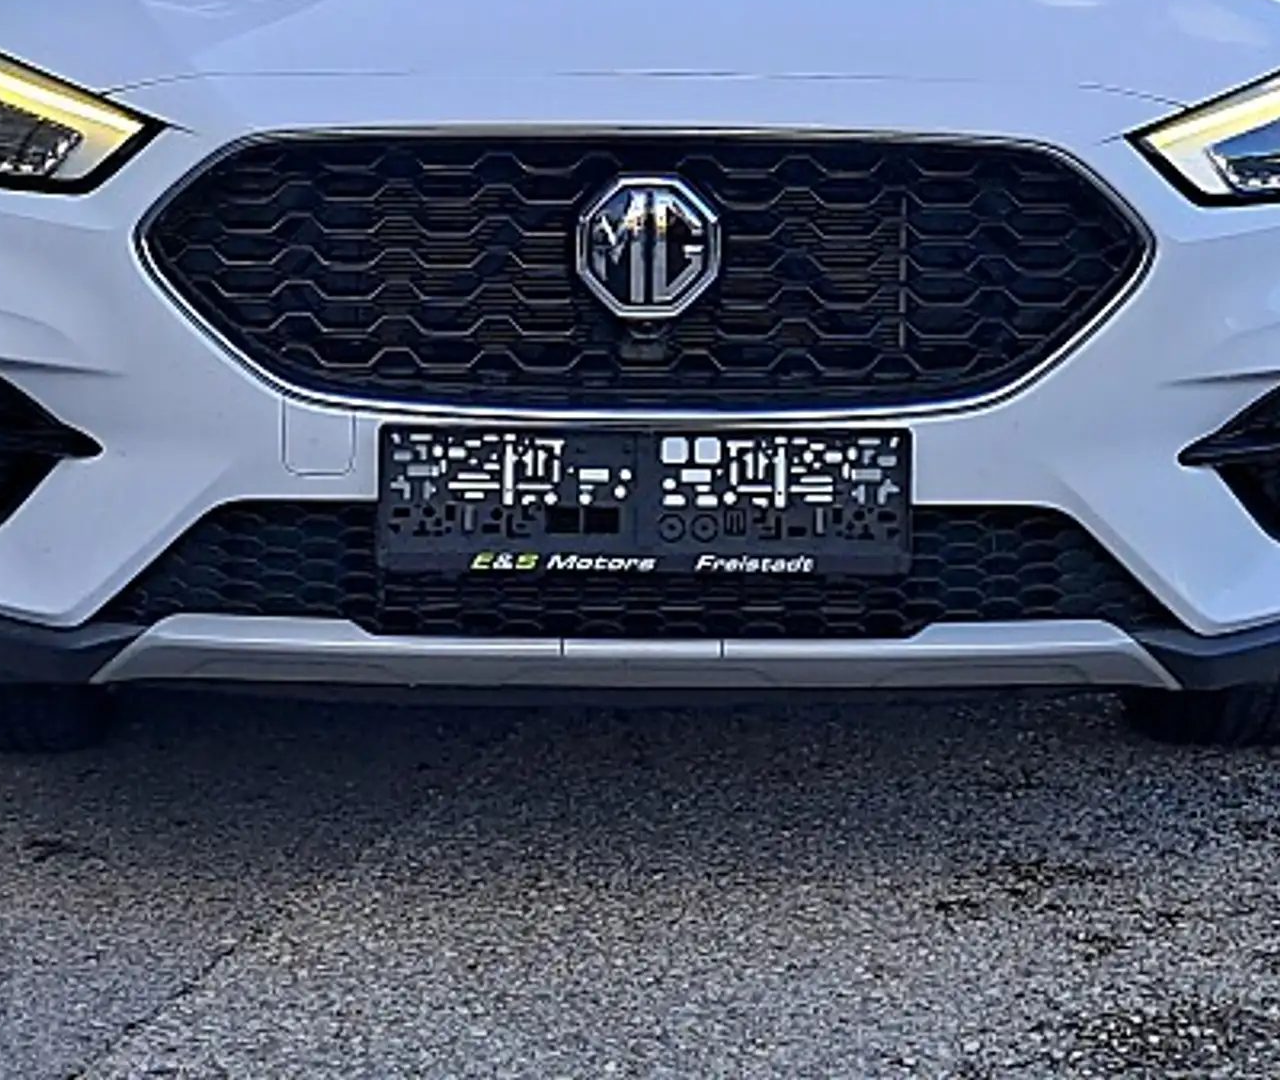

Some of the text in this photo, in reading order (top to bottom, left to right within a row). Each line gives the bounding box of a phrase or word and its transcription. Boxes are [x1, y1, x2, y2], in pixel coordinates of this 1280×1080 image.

[591, 187, 705, 304] MG
[470, 553, 815, 574] E&S Motors Freistadt
